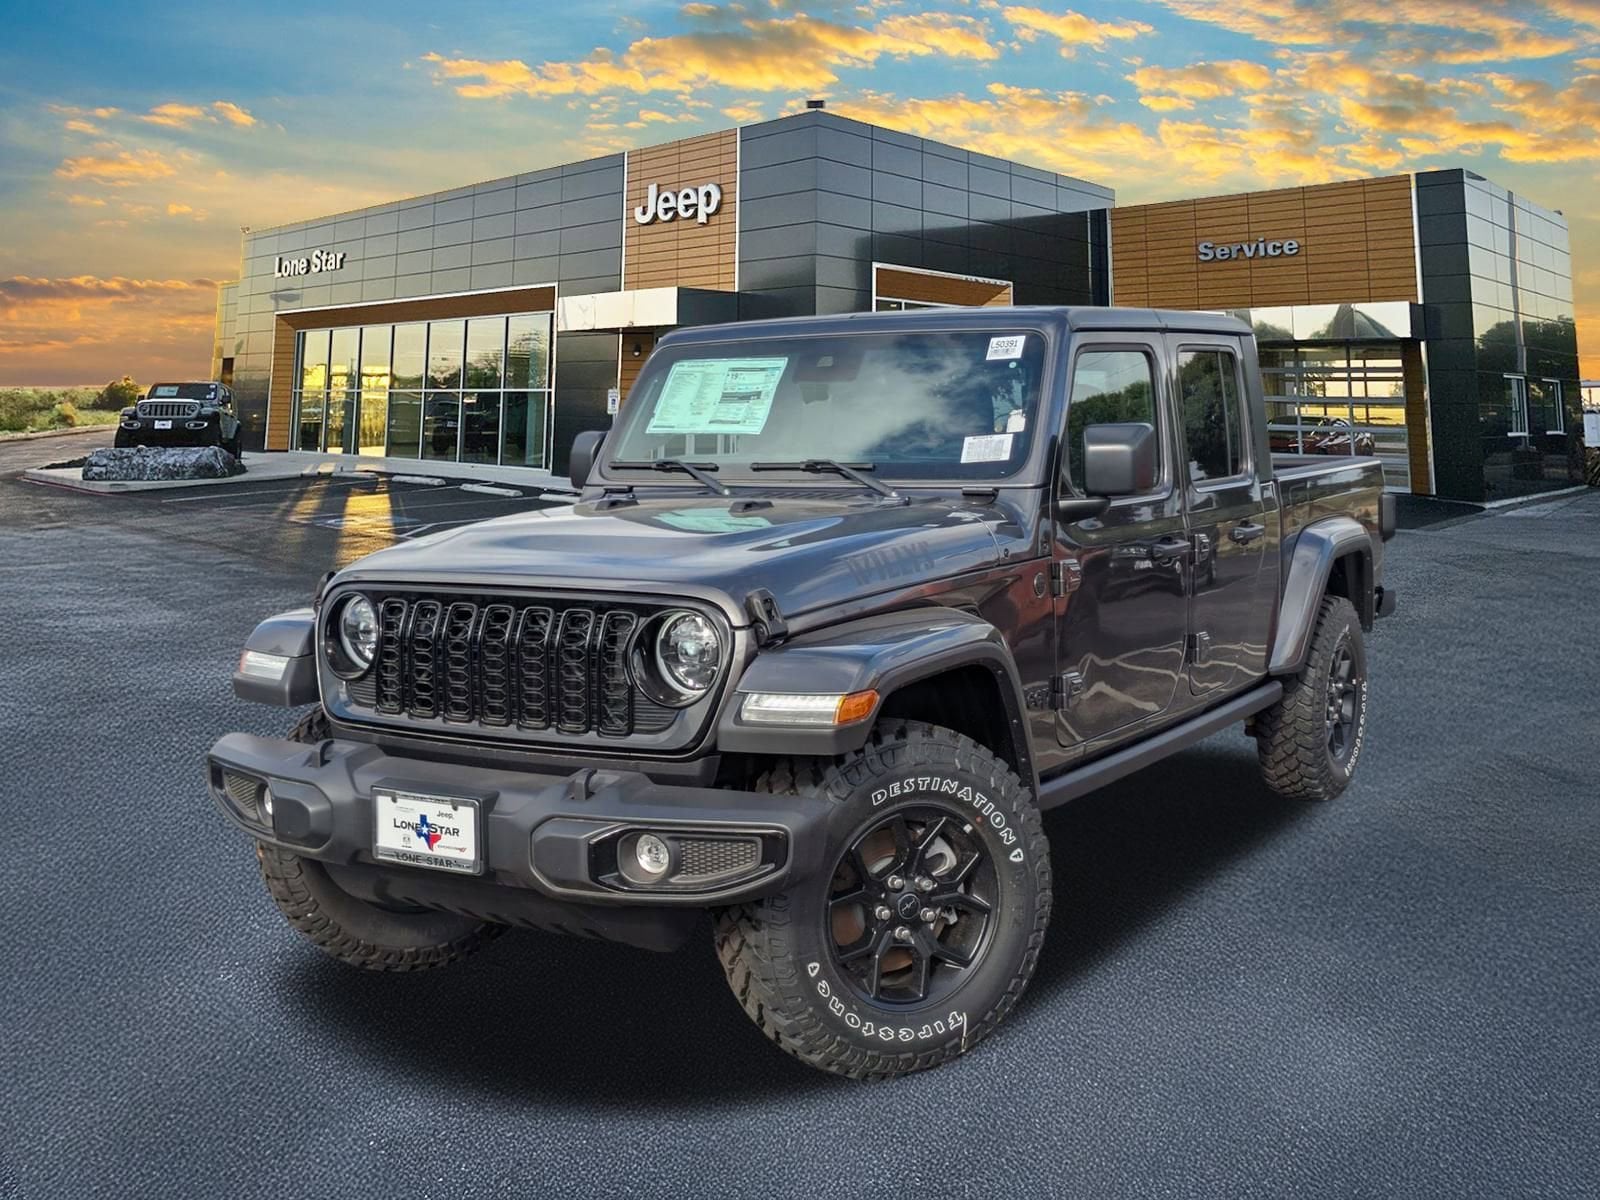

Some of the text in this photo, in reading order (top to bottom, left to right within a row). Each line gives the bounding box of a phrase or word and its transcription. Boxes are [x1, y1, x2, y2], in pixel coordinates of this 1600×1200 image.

[634, 183, 721, 224] Jeep
[274, 249, 345, 278] Lone Star
[1198, 237, 1299, 261] Service
[846, 541, 935, 586] WILLYS
[436, 810, 453, 819] Jeep
[871, 776, 1017, 846] DESTINATION
[393, 817, 460, 837] LONE STAR
[396, 851, 422, 863] LONE
[426, 856, 453, 869] STAR
[817, 979, 963, 1041] Firestone
